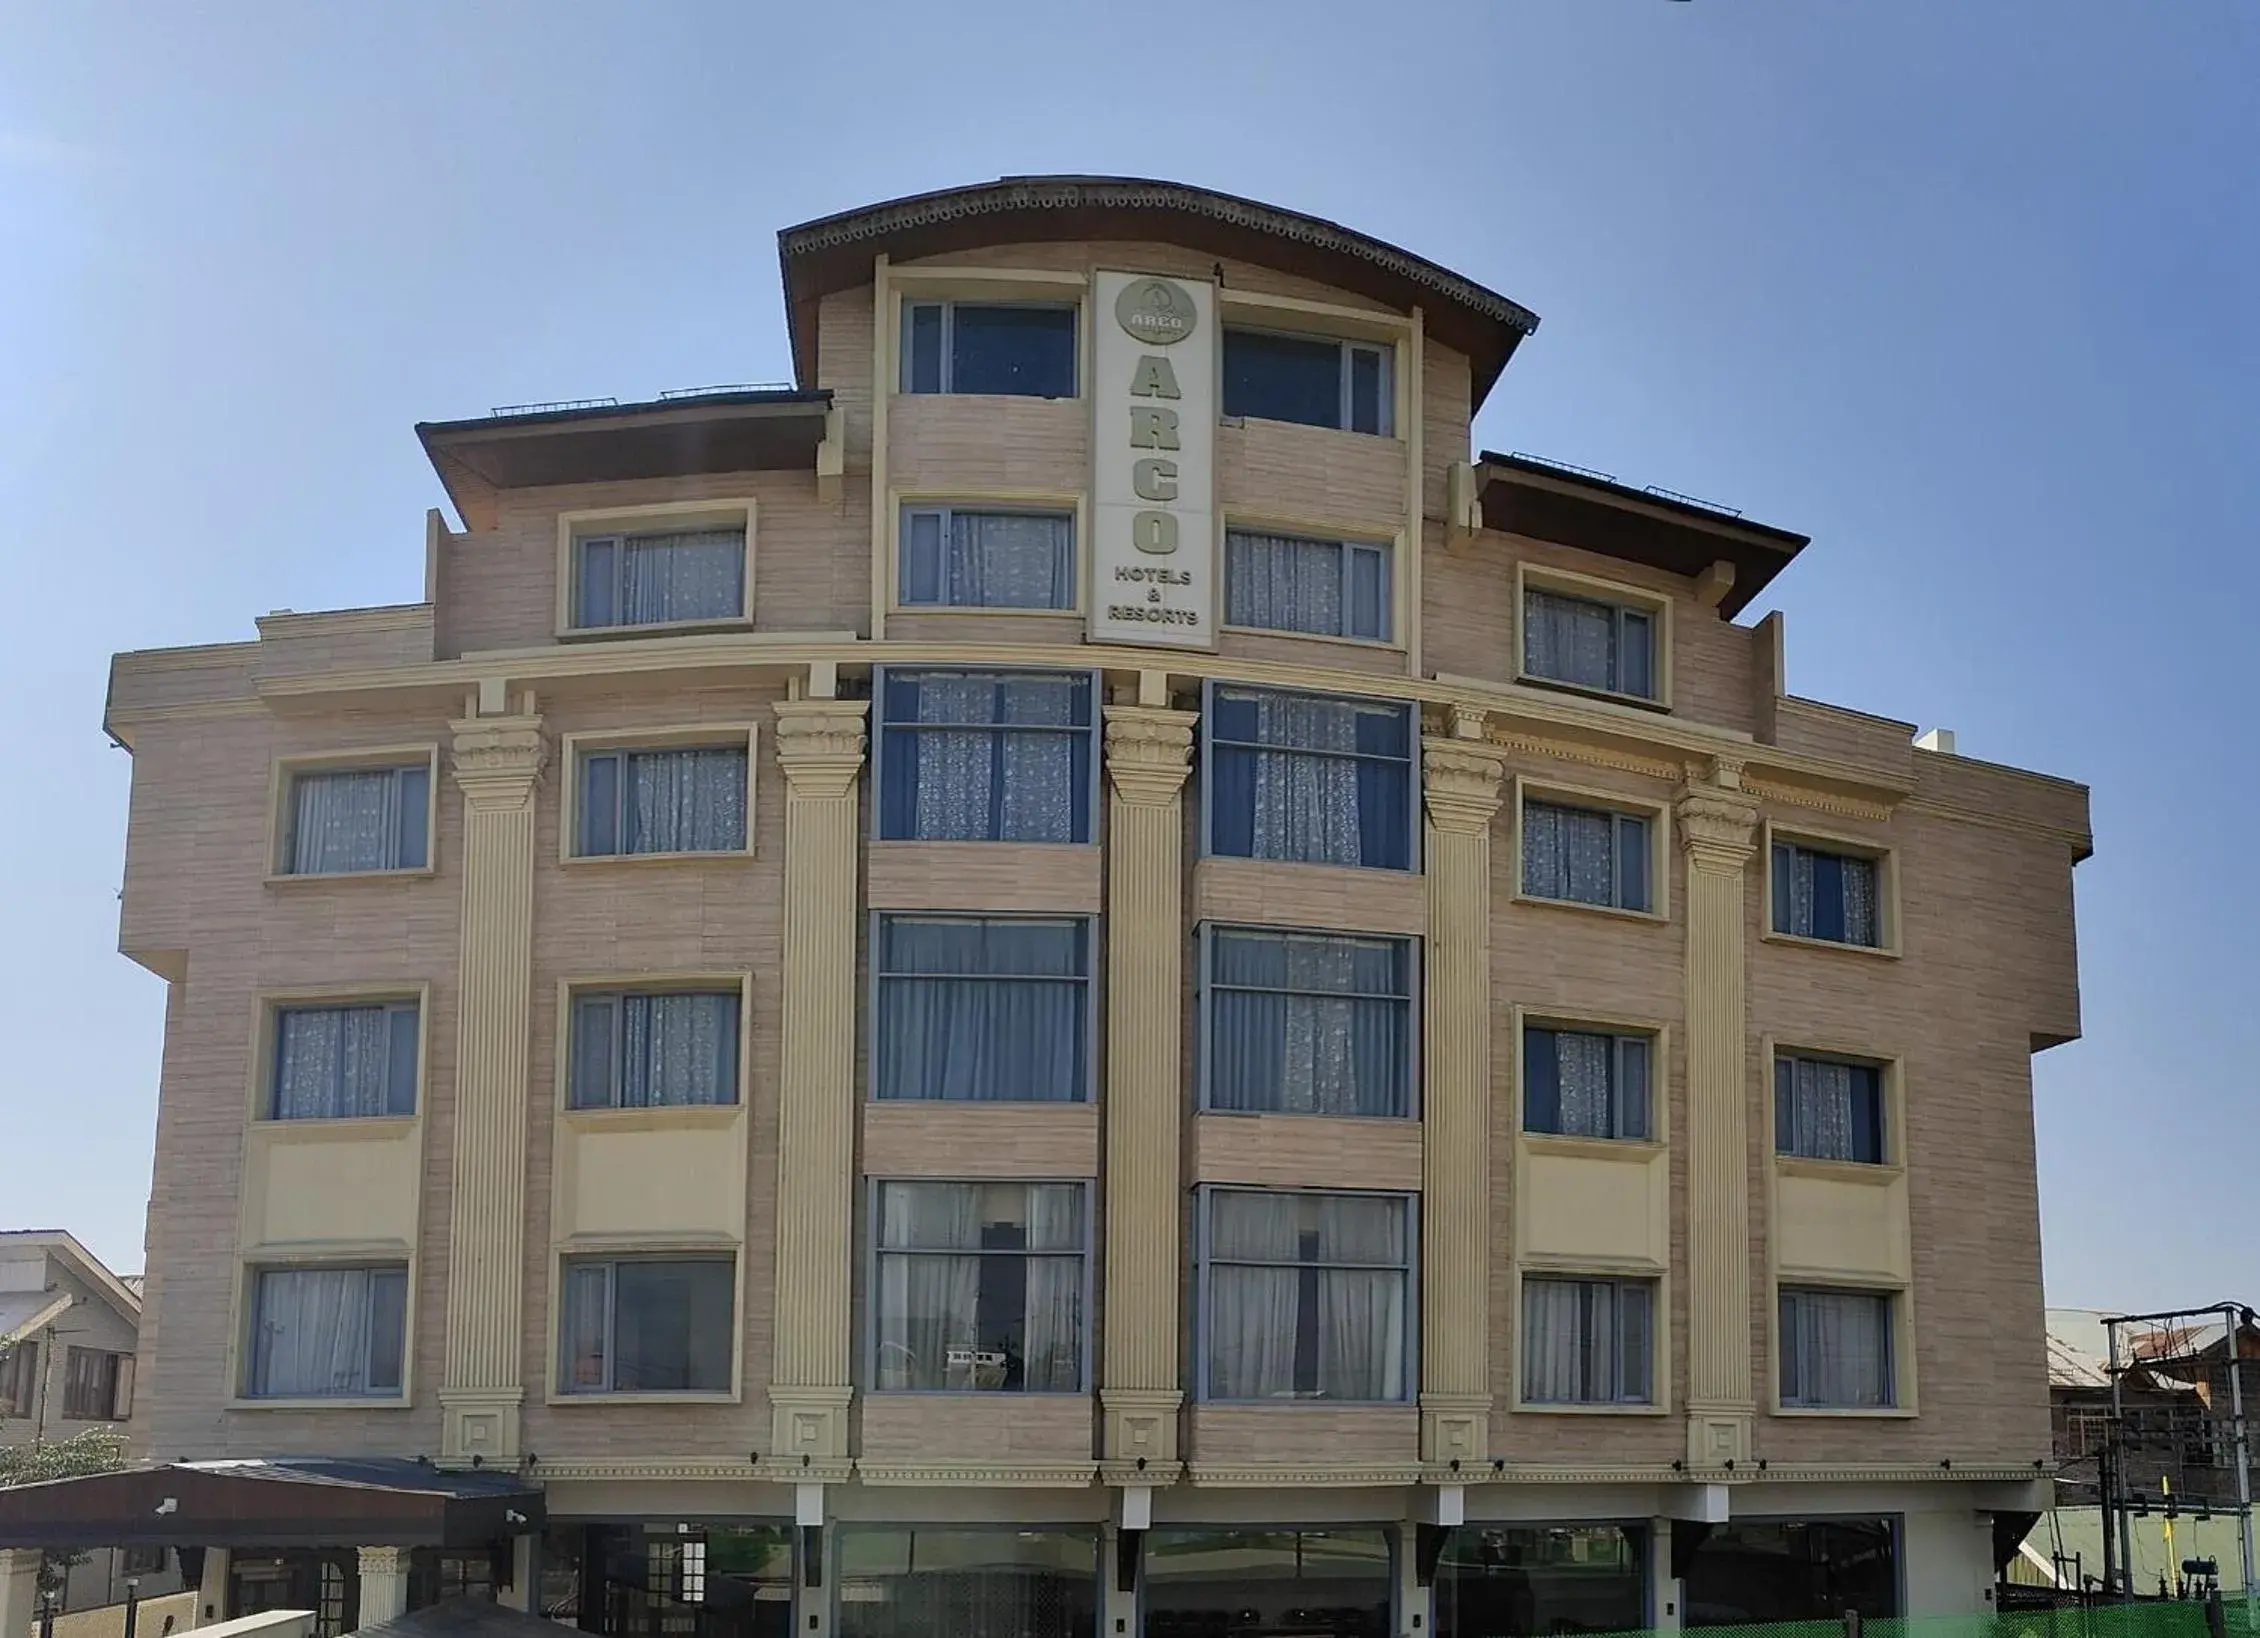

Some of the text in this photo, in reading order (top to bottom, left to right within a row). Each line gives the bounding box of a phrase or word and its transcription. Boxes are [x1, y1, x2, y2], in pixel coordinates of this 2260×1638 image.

[1130, 354, 1181, 555] ARCO
[1114, 566, 1192, 586] HOTELS
[1147, 588, 1161, 602] &
[1107, 604, 1199, 626] RESORTS
